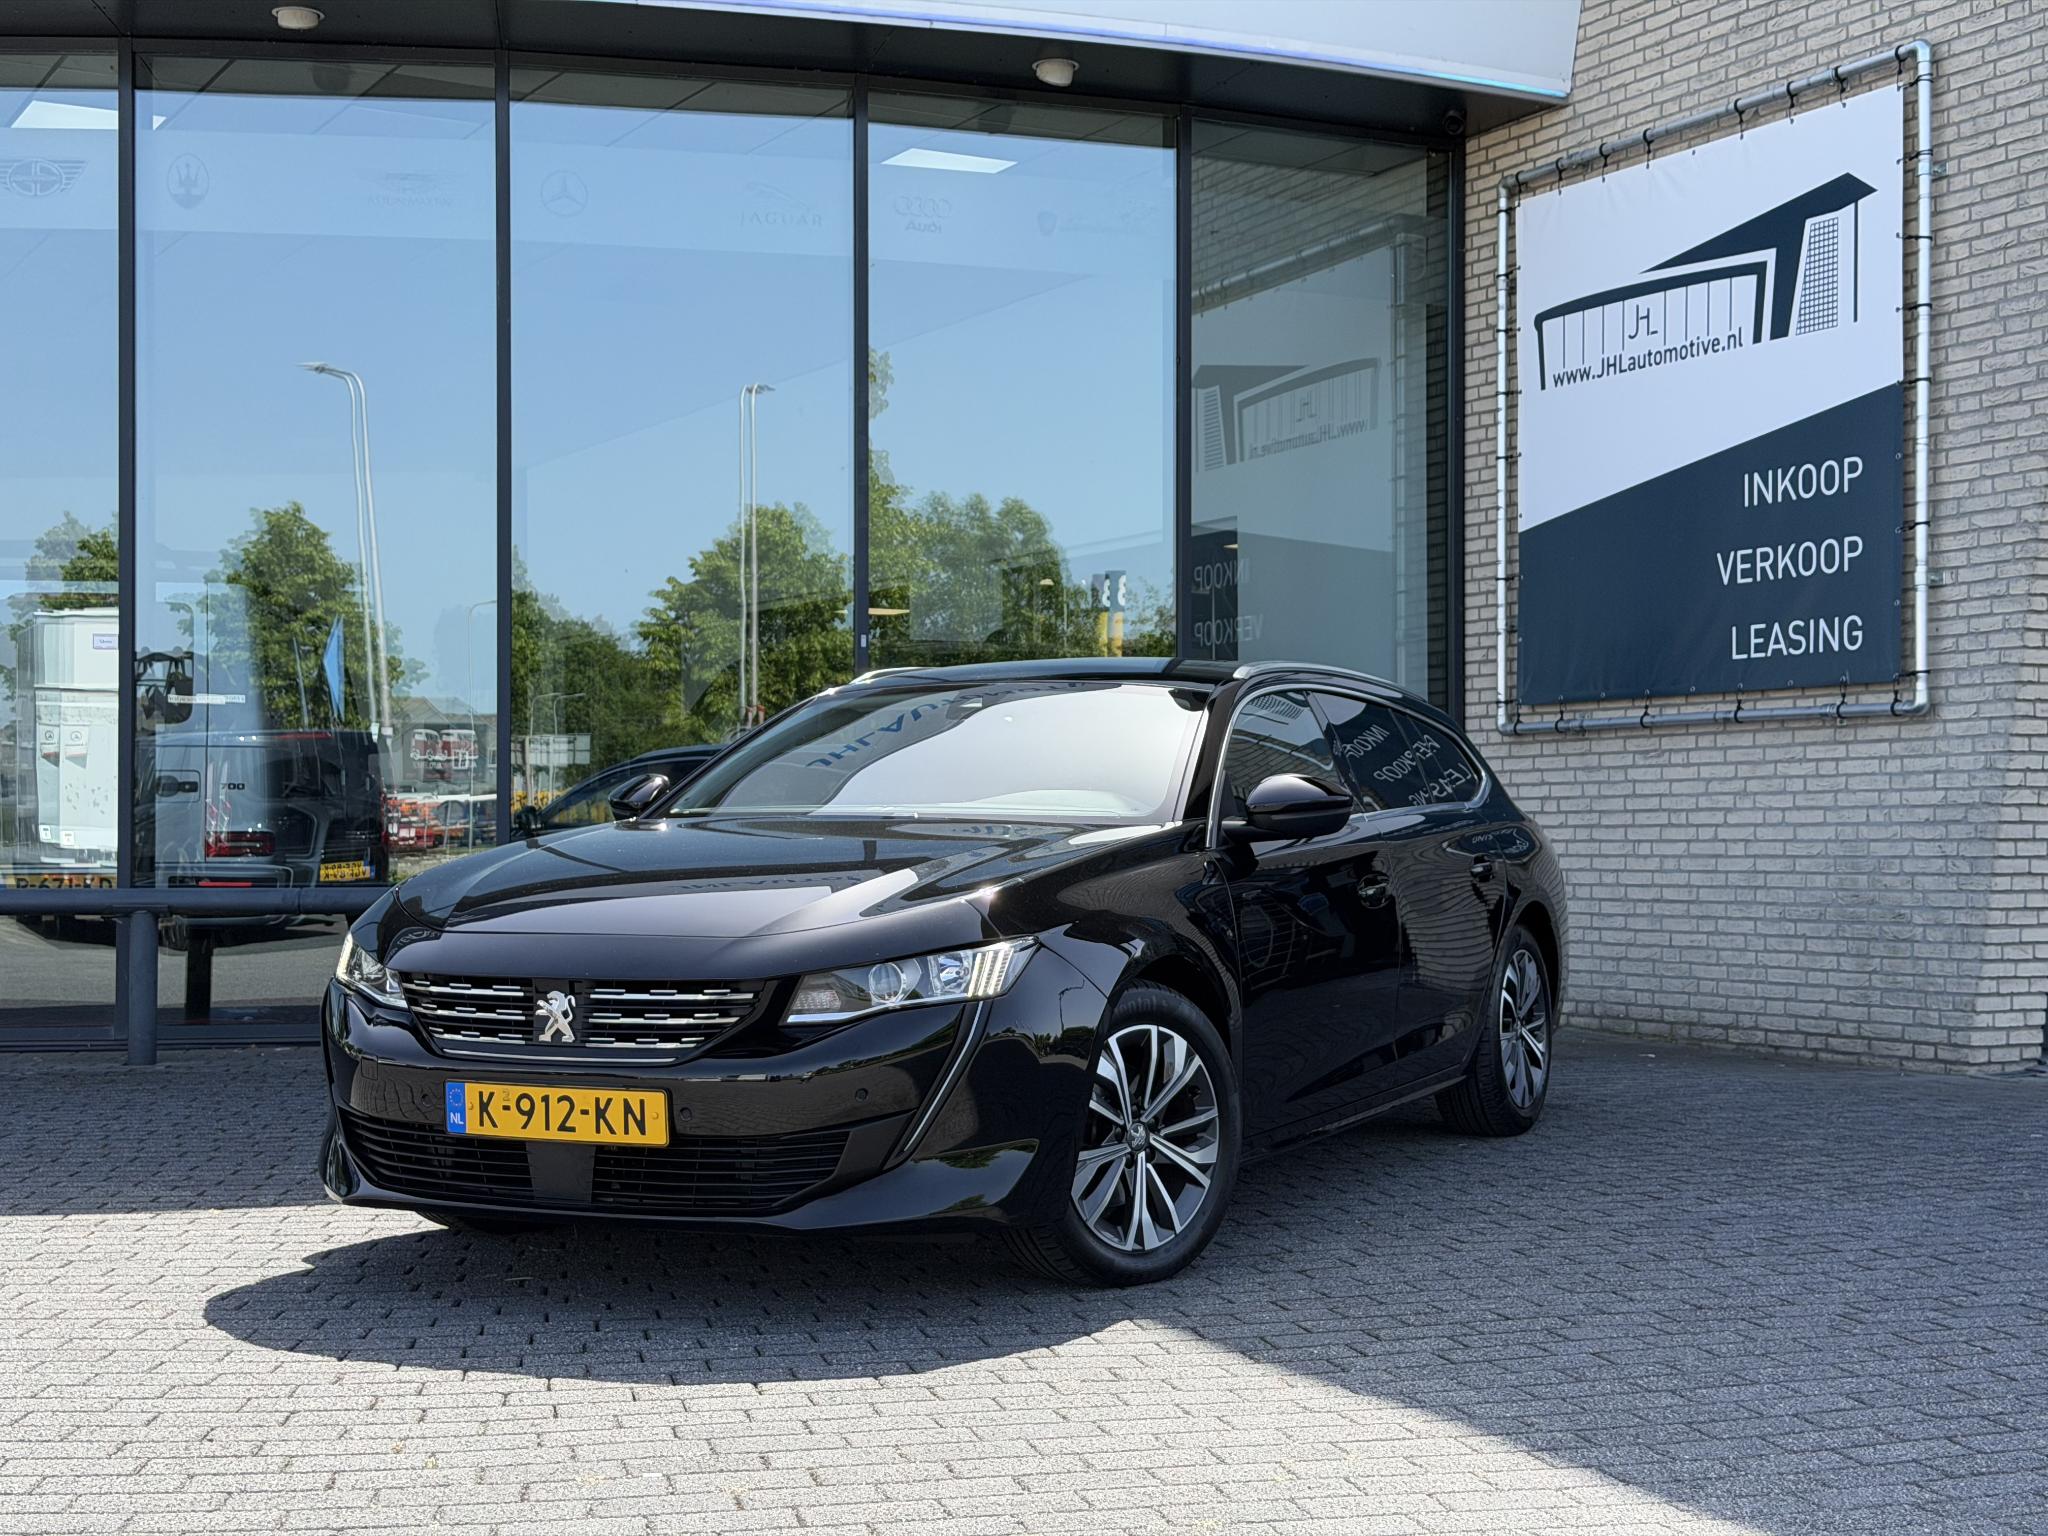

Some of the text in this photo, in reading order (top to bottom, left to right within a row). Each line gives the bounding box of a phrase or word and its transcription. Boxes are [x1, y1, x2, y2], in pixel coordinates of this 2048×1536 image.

[737, 210, 824, 227] JAGUAR
[1628, 304, 1658, 340] JHL
[1552, 326, 1743, 388] www.JHLautomotive.nl
[1744, 456, 1863, 508] INKOOP
[1716, 535, 1863, 586] VERKOOP
[1731, 614, 1863, 660] LEASING
[449, 1112, 465, 1126] NL
[477, 1090, 647, 1136] K-912-KN
